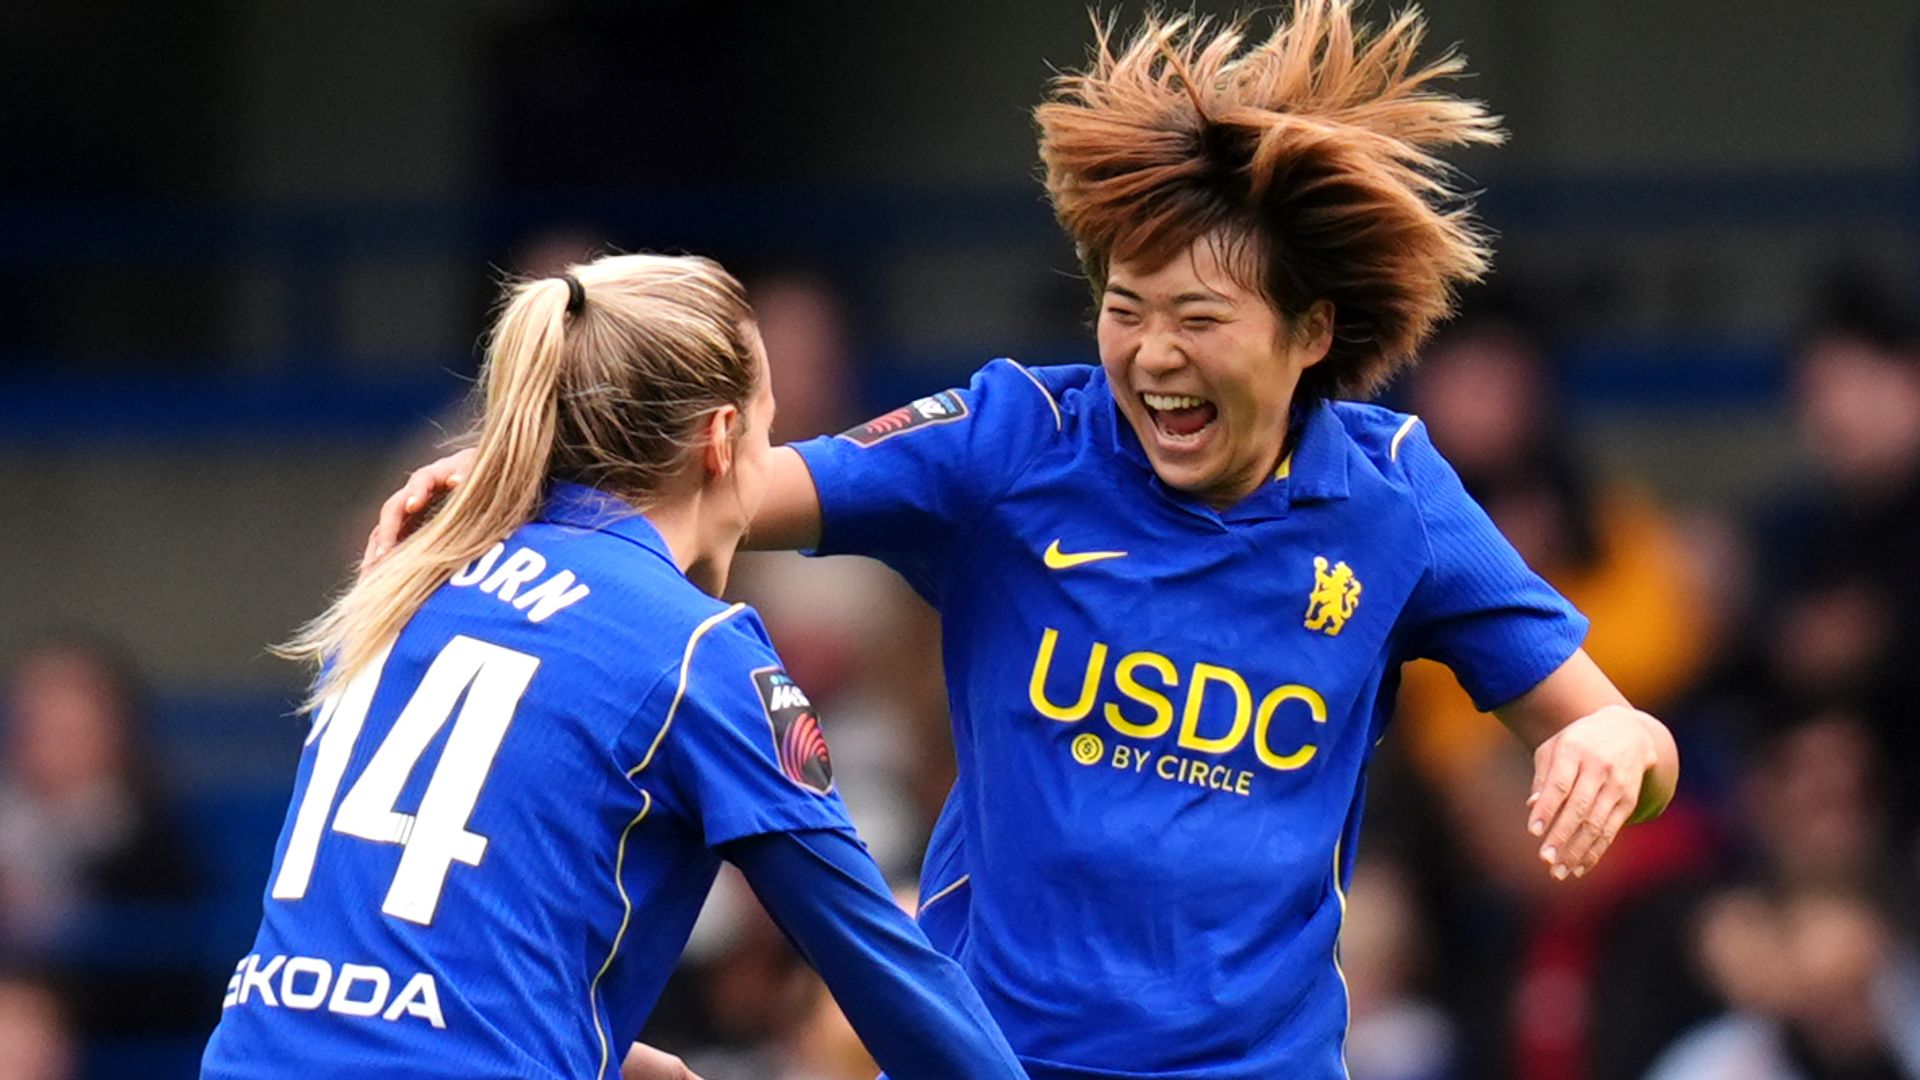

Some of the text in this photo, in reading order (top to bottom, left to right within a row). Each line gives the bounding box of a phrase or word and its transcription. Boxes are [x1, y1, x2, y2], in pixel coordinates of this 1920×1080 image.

[1028, 627, 1327, 771] USDC
[1111, 745, 1255, 796] BY CIRCLE
[271, 634, 541, 926] 14
